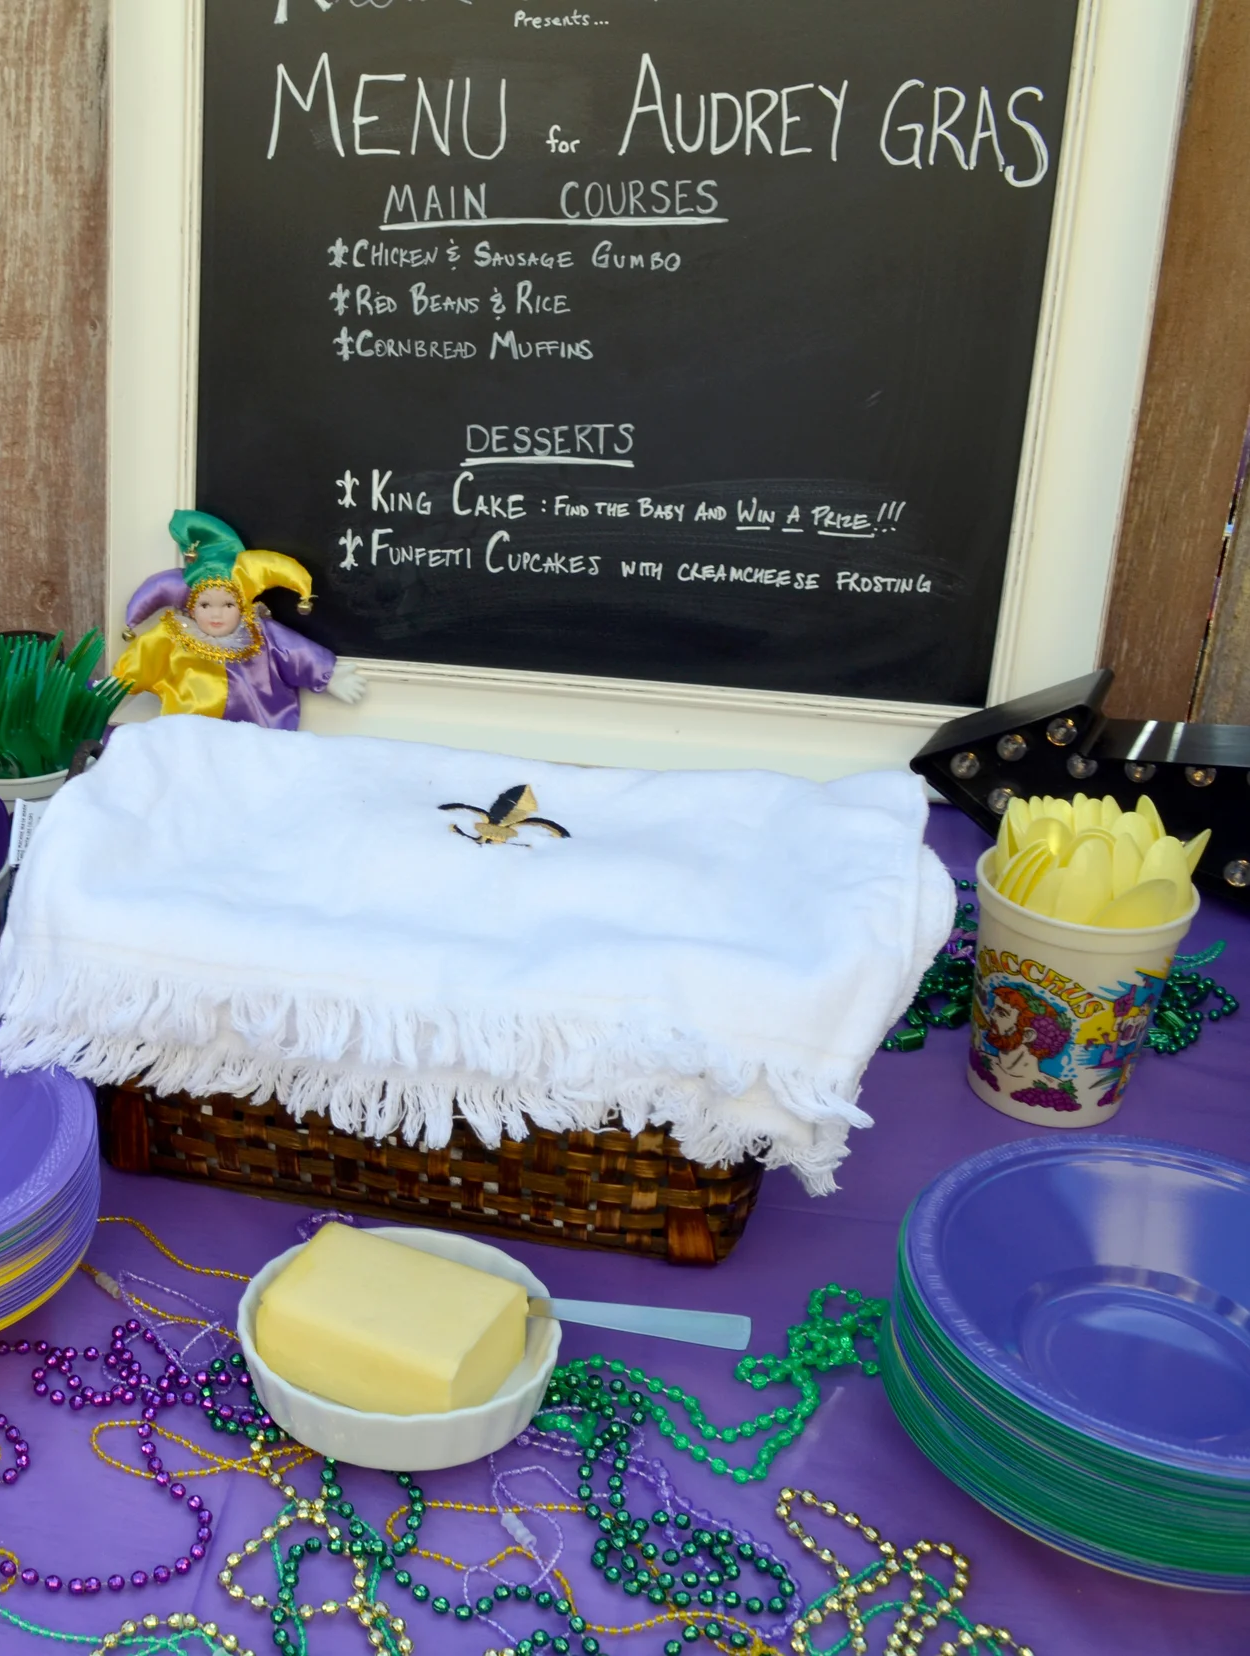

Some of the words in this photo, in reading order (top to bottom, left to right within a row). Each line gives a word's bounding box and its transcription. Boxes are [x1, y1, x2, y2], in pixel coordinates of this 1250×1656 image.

[513, 8, 610, 30] Presents...
[266, 51, 507, 161] MENU
[545, 123, 581, 154] for
[617, 52, 849, 163] AUDREY
[879, 78, 1049, 189] GRAS
[383, 182, 490, 223] MAIN
[560, 179, 719, 217] COURSES
[352, 238, 439, 268] CHICKEN
[473, 240, 575, 270] SAUSAGE
[591, 239, 682, 272] GUMBO
[355, 284, 398, 316] RED
[408, 281, 480, 316] BEANS
[516, 279, 571, 315] RICE
[355, 328, 477, 360] CORNBREAD
[489, 329, 594, 361] MUFFINS
[466, 422, 635, 456] DESSERTS
[371, 468, 432, 516] KING
[553, 494, 590, 518] FIND
[594, 501, 631, 518] THE
[636, 496, 685, 523] BABY
[693, 501, 728, 522] AND
[736, 496, 776, 526] WIN
[786, 504, 801, 525] A
[370, 527, 472, 569] FUNFETTI
[485, 529, 602, 576] CUPCAKES
[620, 560, 663, 581] WITH
[676, 562, 821, 590] CREAMCHEESE
[835, 570, 932, 594] FROSTING
